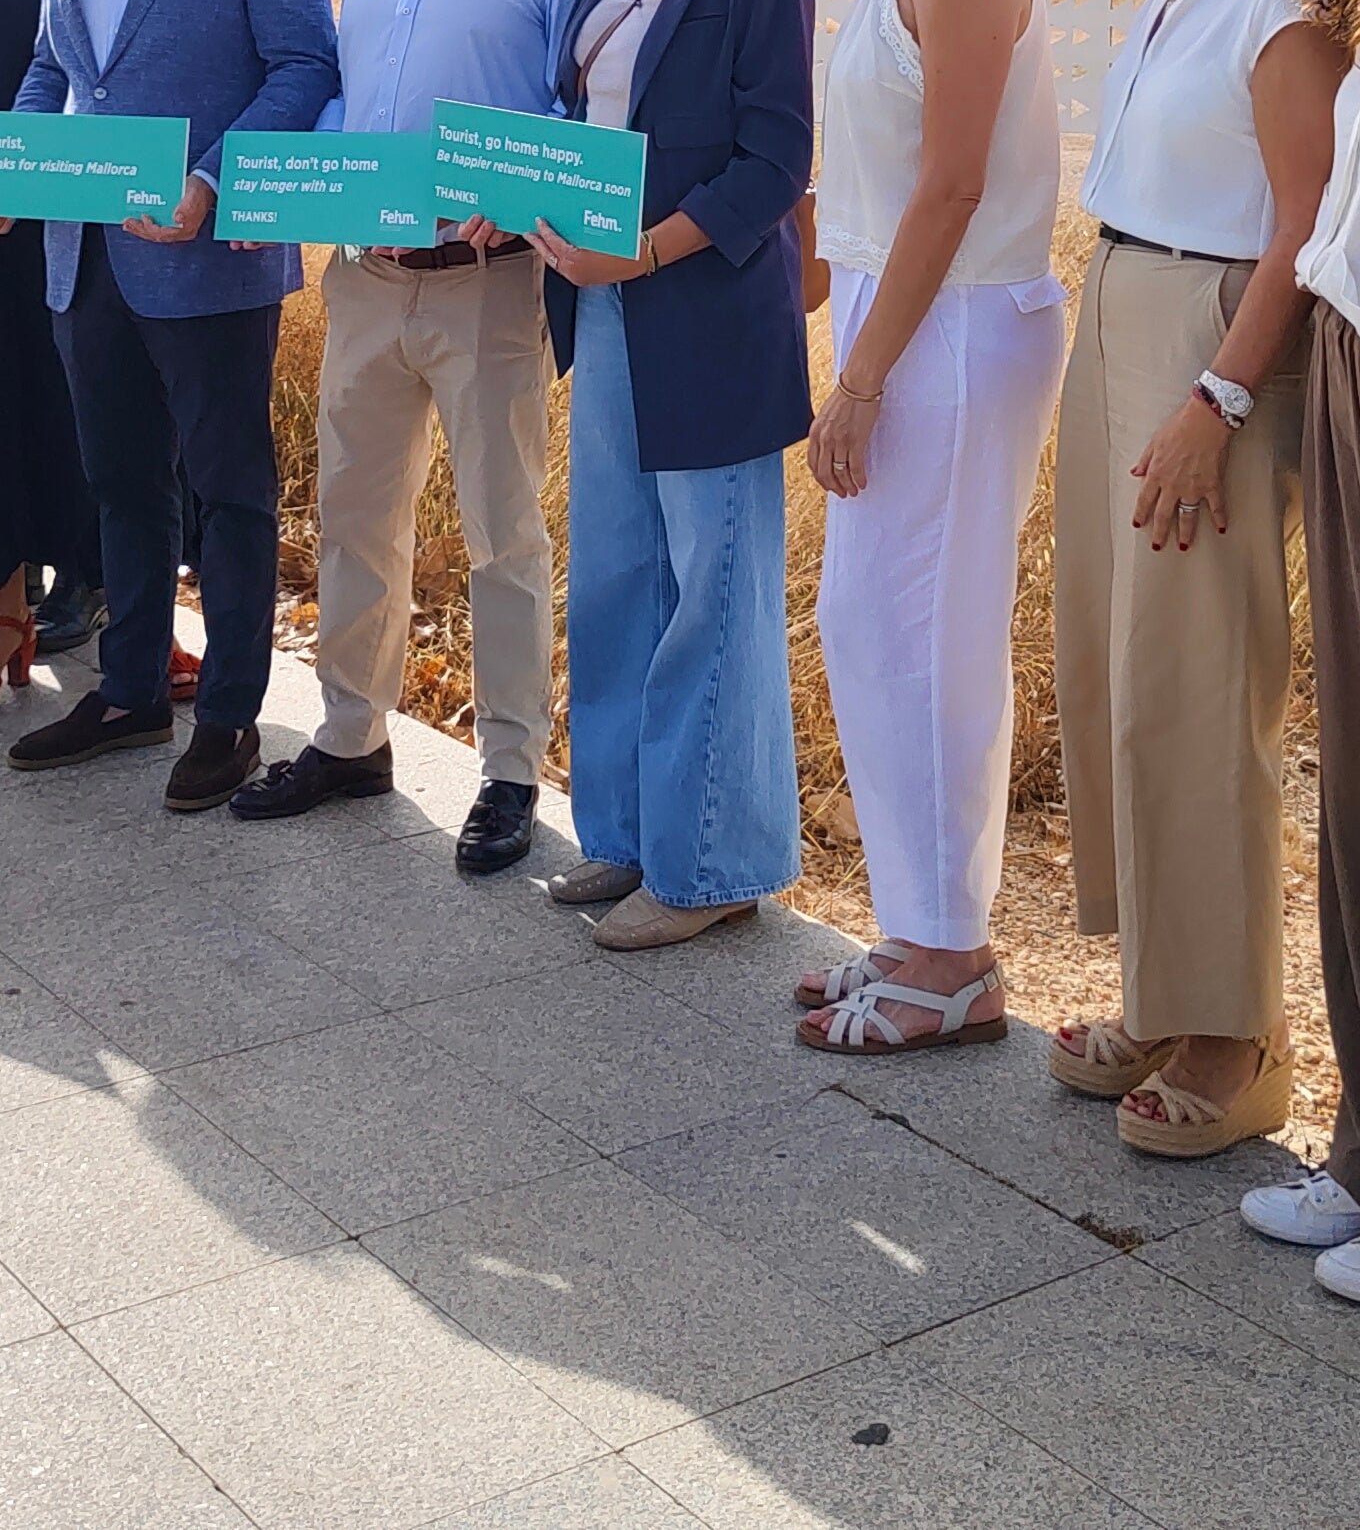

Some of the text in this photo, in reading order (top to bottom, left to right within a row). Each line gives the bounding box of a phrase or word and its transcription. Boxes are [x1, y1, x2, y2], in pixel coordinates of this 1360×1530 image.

[439, 125, 584, 166] Tourist, go home happy.
[18, 158, 37, 171] for
[39, 159, 84, 176] visiting
[86, 162, 138, 176] Mallorca
[236, 155, 379, 173] Tourist, don't go home
[436, 149, 632, 198] Be happier returning to Mallorca soon
[232, 178, 344, 194] stay longer with us
[126, 189, 167, 206] Fehm.
[434, 185, 480, 206] THANKS!
[231, 210, 278, 223] THANKS!
[379, 209, 419, 225] Fehm.
[583, 209, 623, 233] Fehm.
